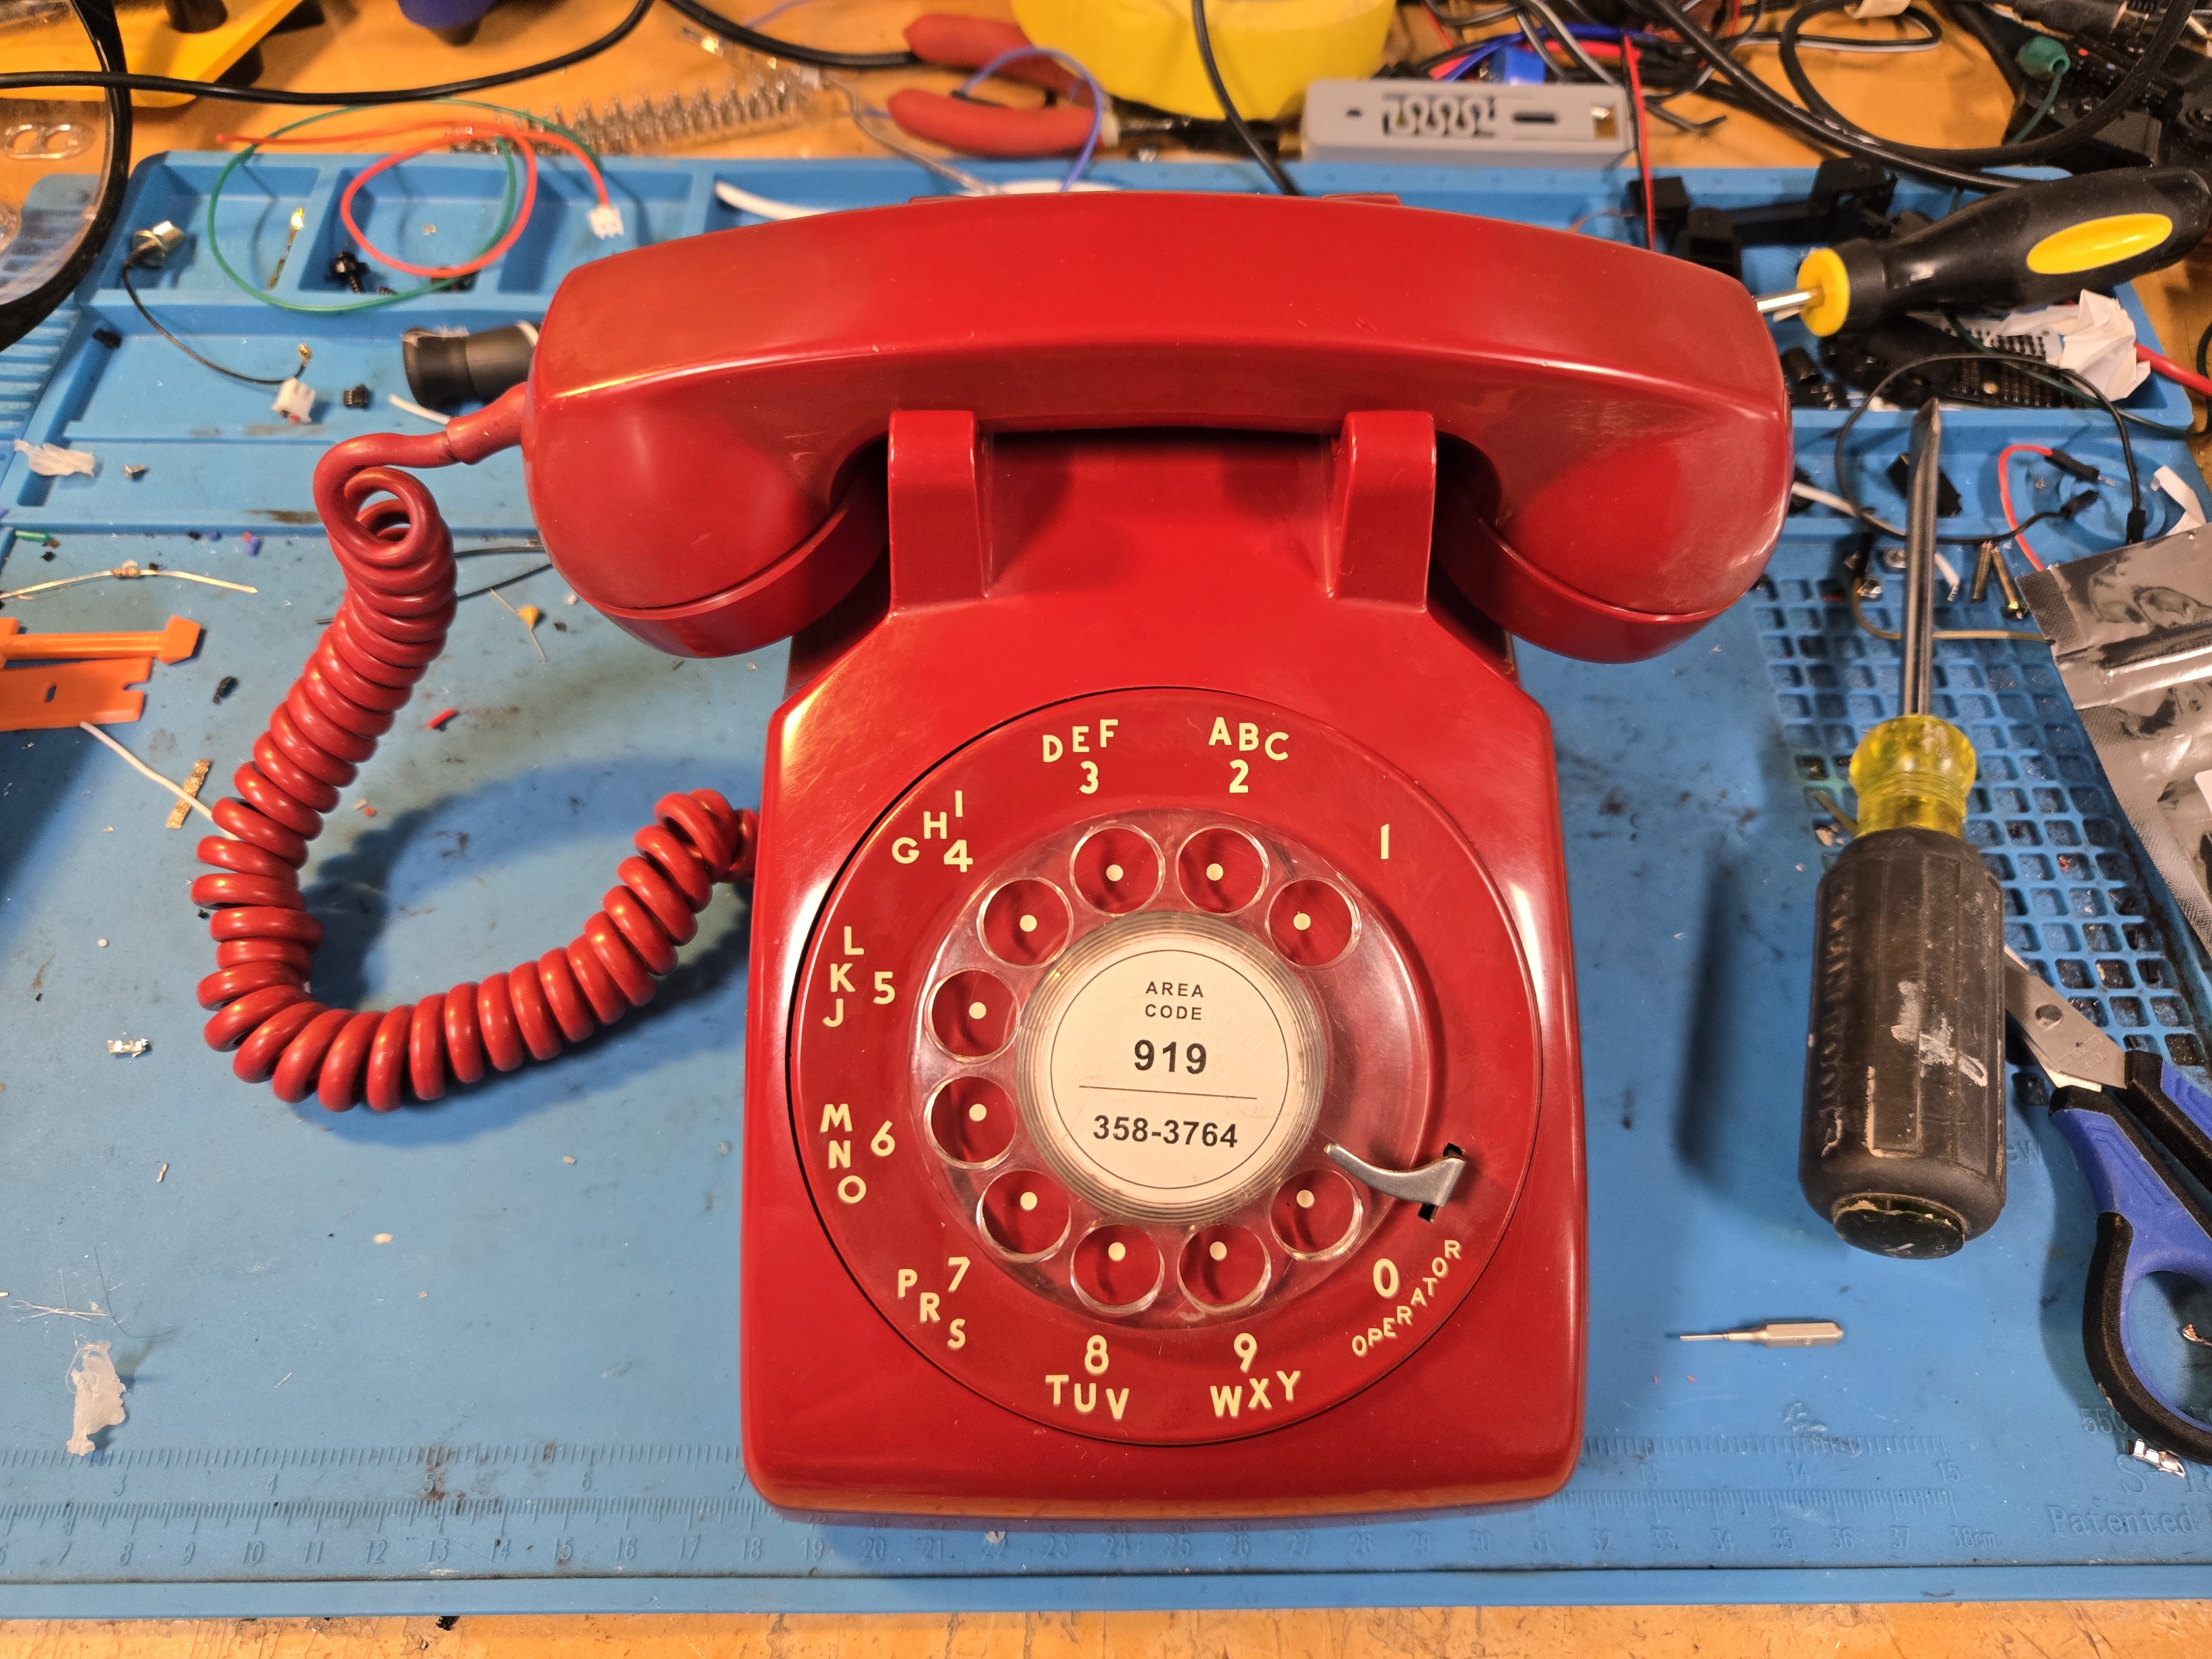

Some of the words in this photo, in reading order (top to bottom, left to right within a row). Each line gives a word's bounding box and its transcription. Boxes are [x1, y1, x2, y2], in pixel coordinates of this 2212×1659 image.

[1042, 719, 1119, 763] DEF
[1208, 717, 1289, 761] ABC
[1079, 760, 1099, 794] 3
[1229, 759, 1249, 793] 2
[891, 790, 963, 864] GHI
[1380, 823, 1390, 859] 1
[943, 839, 973, 873] 4
[873, 971, 895, 1005] 5
[1145, 981, 1203, 998] AREA
[1145, 1004, 1202, 1020] CODE
[1134, 1039, 1207, 1074] 919
[871, 1120, 895, 1156] 6
[1093, 1115, 1238, 1148] 358-3764
[948, 1256, 971, 1291] 7
[1373, 1258, 1399, 1297] 0
[898, 1269, 966, 1348] PRS
[1352, 1240, 1461, 1357] OPERATOR
[1084, 1334, 1109, 1374] 8
[1234, 1333, 1257, 1372] 9
[1045, 1374, 1129, 1419] TUV
[1210, 1370, 1301, 1417] WXY
[113, 1474, 127, 1497] 3
[265, 1473, 278, 1495] 4
[422, 1472, 436, 1494] 5
[581, 1470, 592, 1491] 6
[2047, 1504, 2198, 1537] Patented
[58, 1541, 72, 1566] 7
[119, 1542, 134, 1566] 8
[182, 1541, 196, 1565] 9
[241, 1540, 264, 1564] 10
[304, 1540, 324, 1564] 11
[366, 1538, 388, 1564] 12
[426, 1538, 450, 1563] 13
[491, 1537, 512, 1562] 14
[553, 1536, 574, 1561] 15
[614, 1535, 637, 1561] 16
[678, 1533, 702, 1561] 17
[742, 1536, 762, 1561] 18
[801, 1537, 825, 1562] 19
[861, 1536, 885, 1561] 20
[1530, 1530, 1549, 1552] 31
[1589, 1528, 1613, 1552] 32
[1651, 1527, 1677, 1550] 33
[1710, 1527, 1735, 1551] 34
[1770, 1527, 1795, 1550] 35
[1829, 1527, 1854, 1549] 36
[1890, 1525, 1911, 1549] 37
[1948, 1525, 1997, 1549] 38cm
